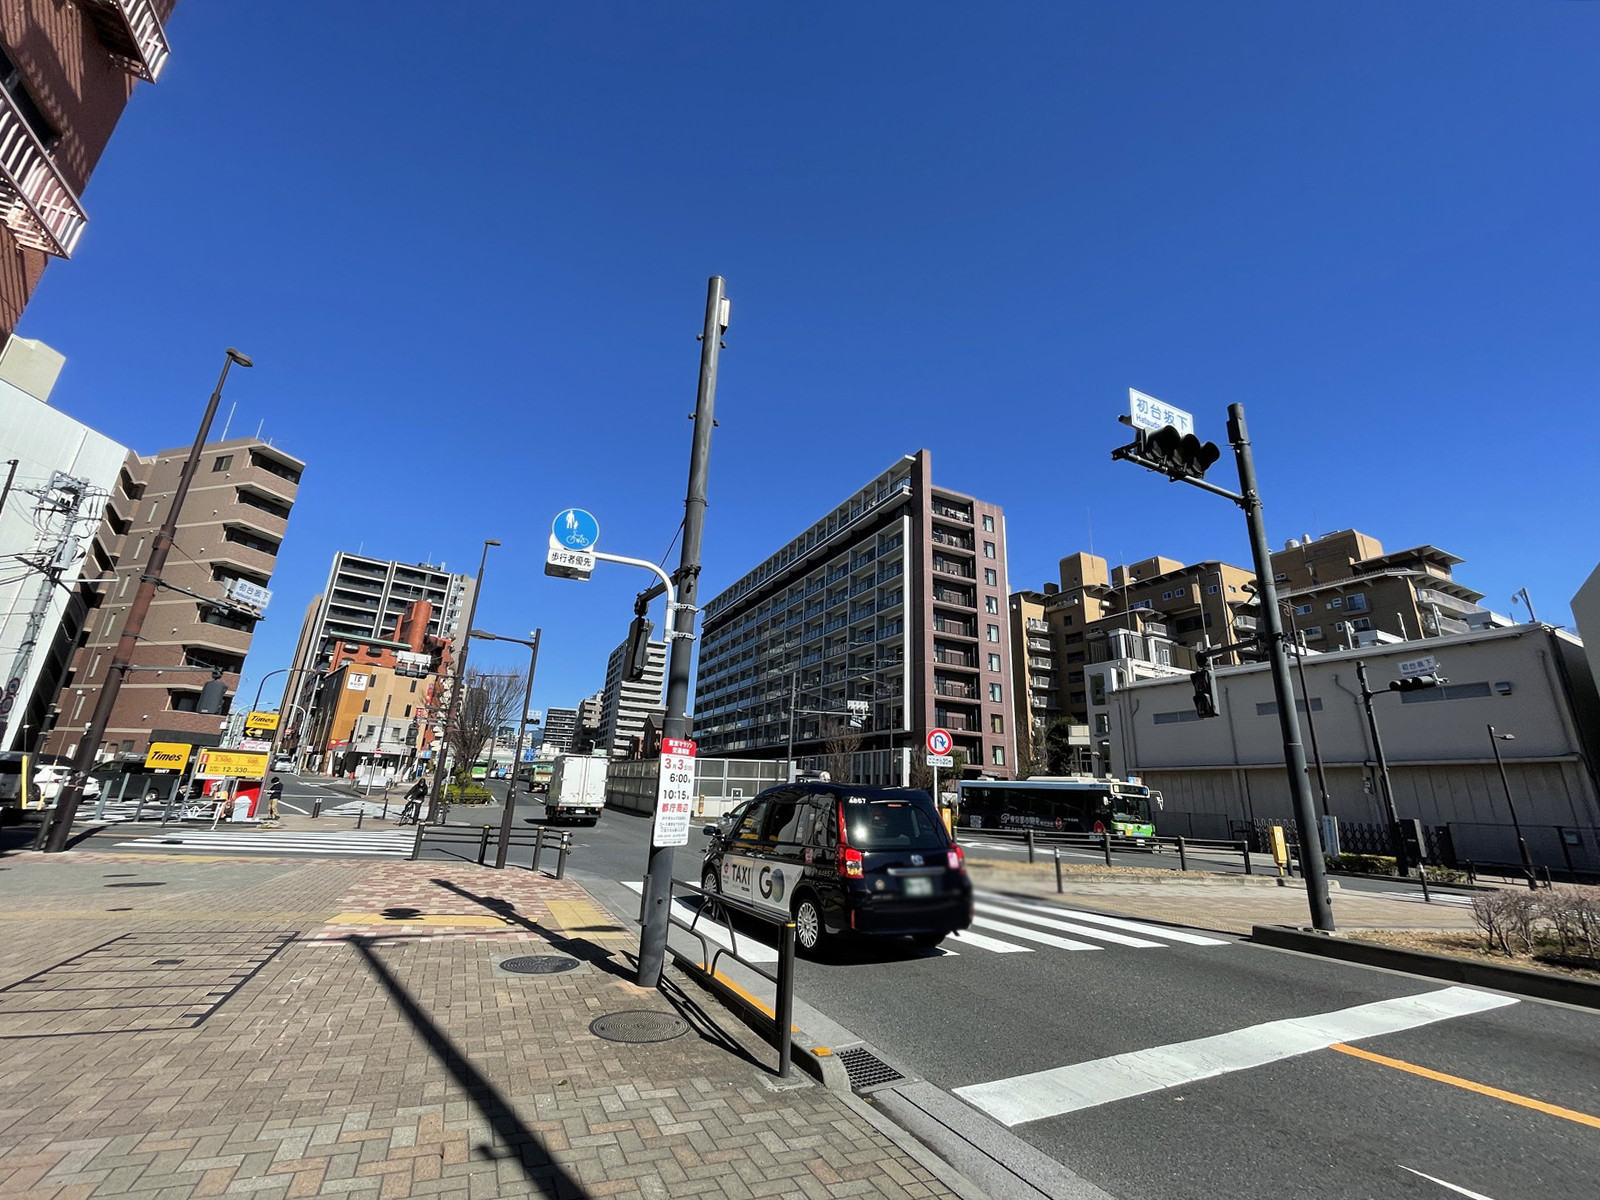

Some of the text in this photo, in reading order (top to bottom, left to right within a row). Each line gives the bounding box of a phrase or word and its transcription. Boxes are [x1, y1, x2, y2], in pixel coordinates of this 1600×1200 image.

[1136, 397, 1188, 430] 初台坂下
[551, 551, 591, 567] 歩行者優先
[239, 583, 270, 600] 初台坂下
[251, 715, 275, 724] Times
[151, 751, 183, 762] Times
[732, 863, 751, 886] TAXI
